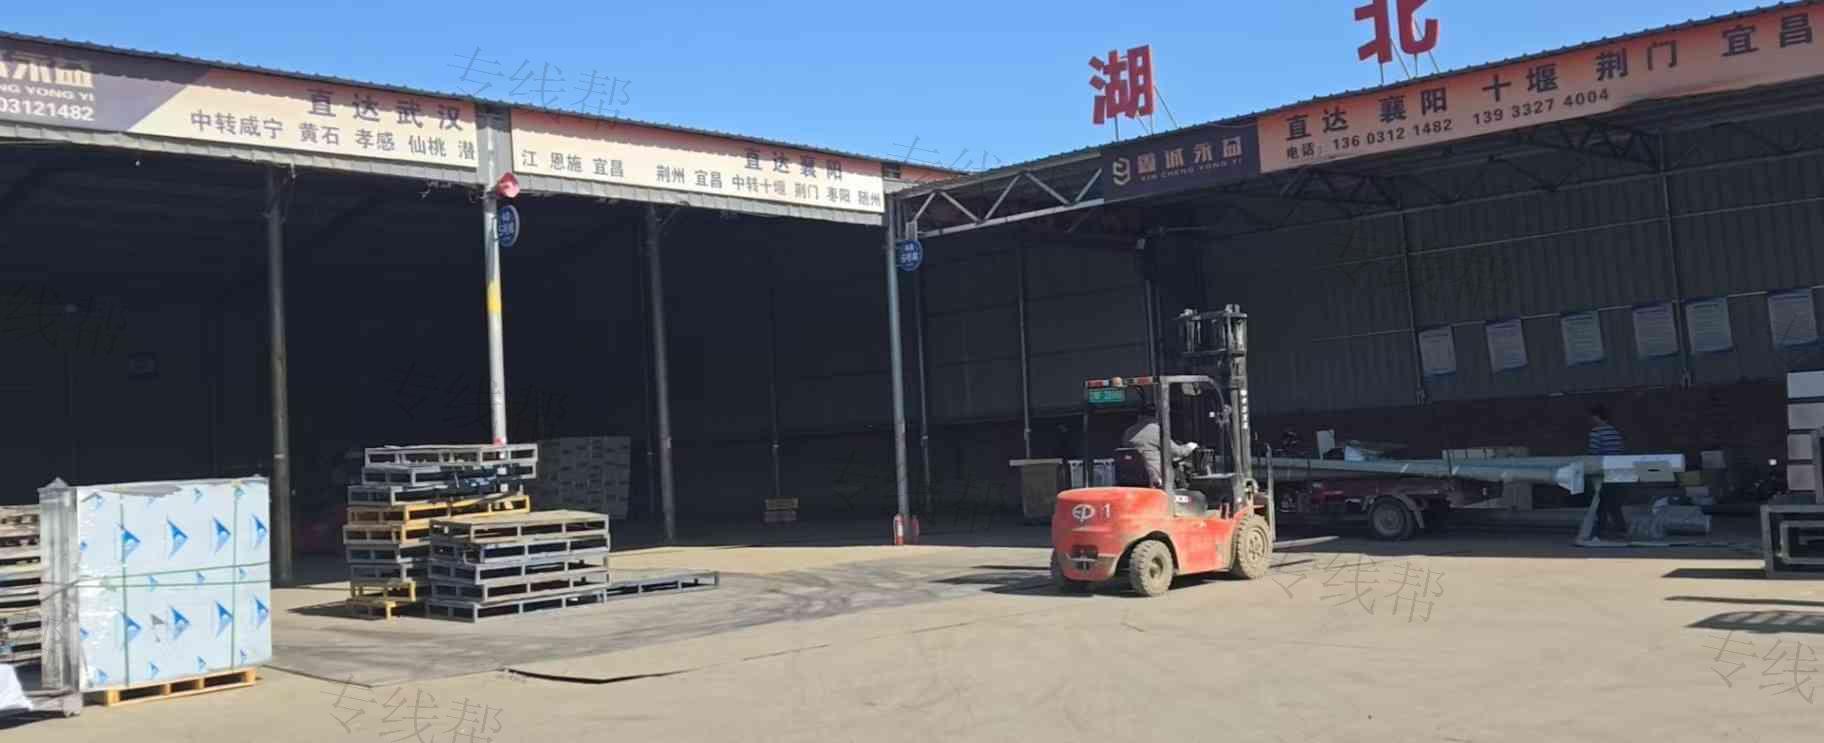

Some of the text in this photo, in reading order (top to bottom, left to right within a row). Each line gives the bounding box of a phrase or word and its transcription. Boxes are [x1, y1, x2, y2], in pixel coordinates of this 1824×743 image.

[1354, 0, 1439, 64] 北
[25, 86, 74, 99] YONG
[79, 92, 94, 101] YI
[1089, 45, 1154, 125] 湖
[1286, 12, 1814, 141] 直达 襄阳 十堰 荆门 宜昌
[307, 88, 463, 131] 直达武汉
[1333, 135, 1360, 150] 136
[1367, 127, 1405, 144] 0312
[1413, 119, 1452, 136] 1482
[1473, 108, 1503, 125] 139
[1511, 98, 1555, 119] 3327
[1562, 88, 1609, 108] 4004
[299, 122, 340, 145] 黄石
[408, 135, 446, 157] 仙桃
[521, 149, 538, 168] 江
[550, 152, 583, 173] 恩施
[592, 158, 624, 178] 宜昌
[694, 169, 722, 188] 宜昌
